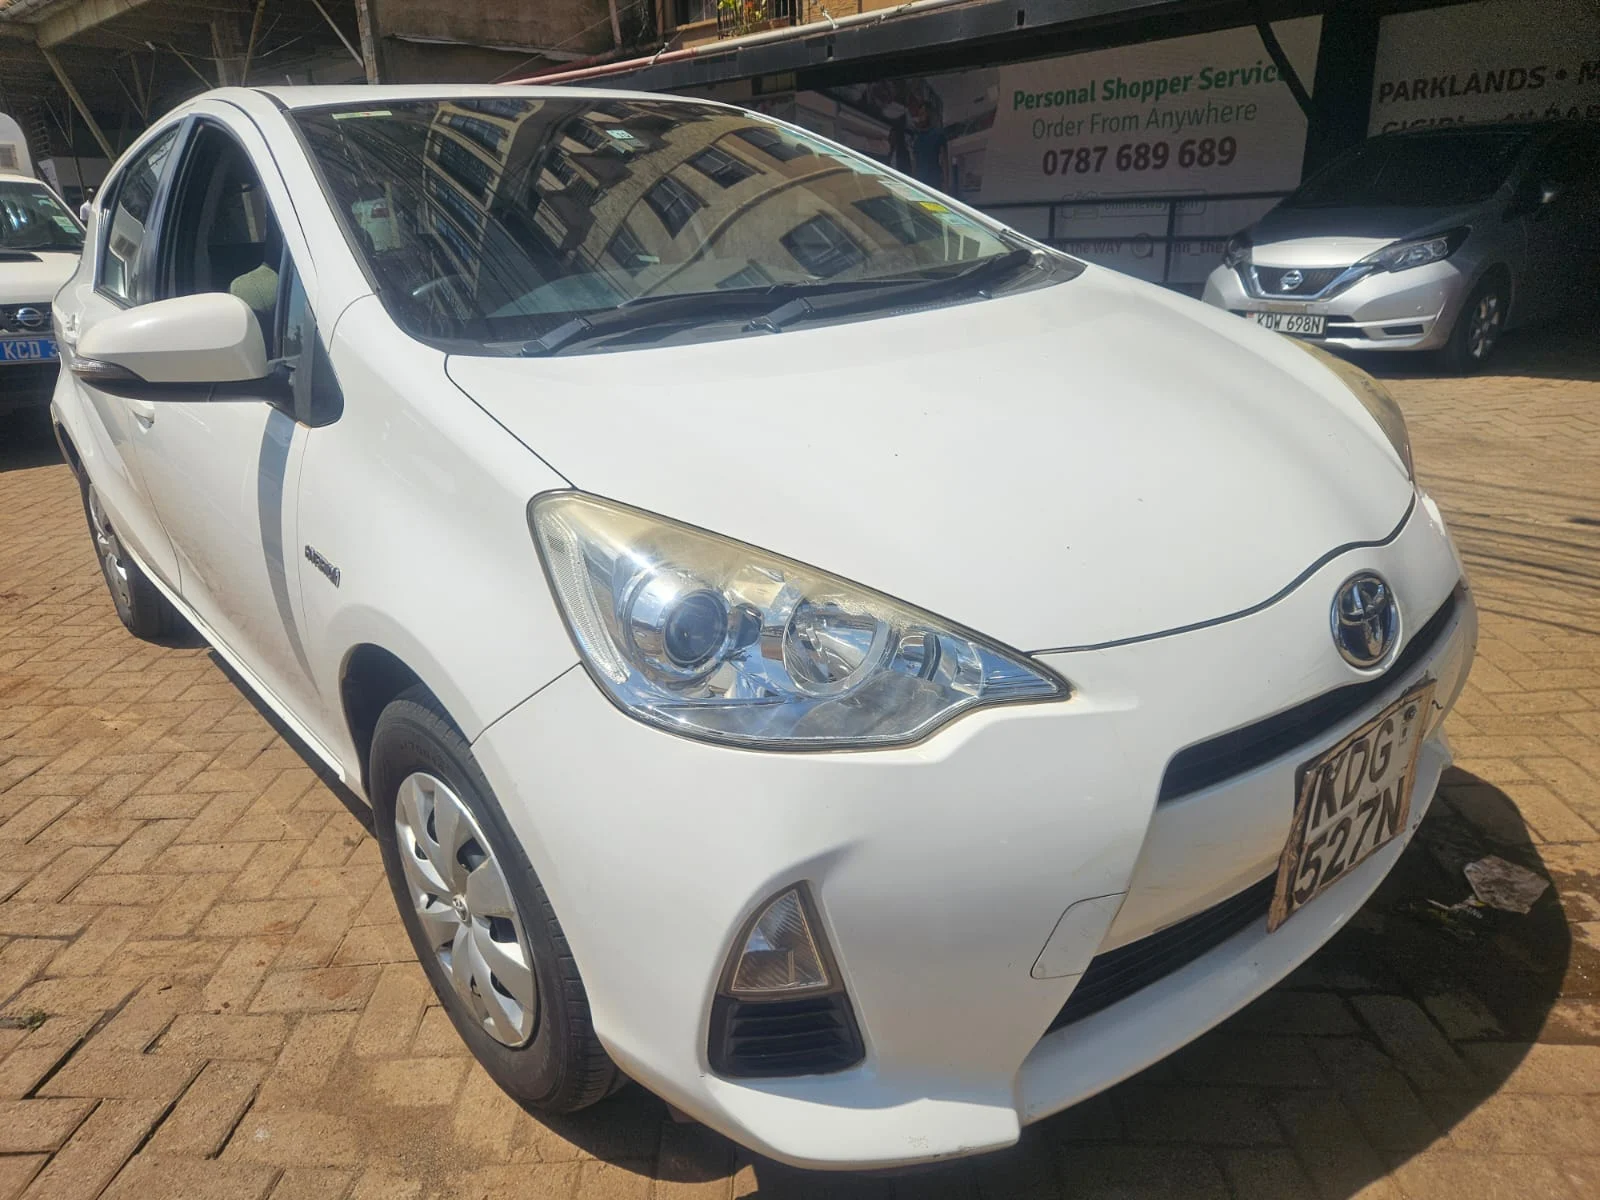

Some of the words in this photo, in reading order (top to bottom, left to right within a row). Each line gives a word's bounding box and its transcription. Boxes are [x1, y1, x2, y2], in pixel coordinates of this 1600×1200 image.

[1013, 80, 1095, 111] Personal
[1101, 74, 1192, 101] Shopper
[1378, 65, 1547, 104] PARKLANDS
[1032, 118, 1084, 140] Order
[1090, 112, 1139, 134] From
[1146, 102, 1257, 134] Anywhere
[1042, 145, 1108, 176] 0787
[1115, 141, 1169, 172] 689
[1178, 136, 1237, 168] 689
[1257, 313, 1282, 329] KDW
[1287, 315, 1320, 333] 698N
[3, 341, 41, 360] KCD
[1311, 718, 1394, 830] KDG
[1293, 776, 1405, 903] 527N
